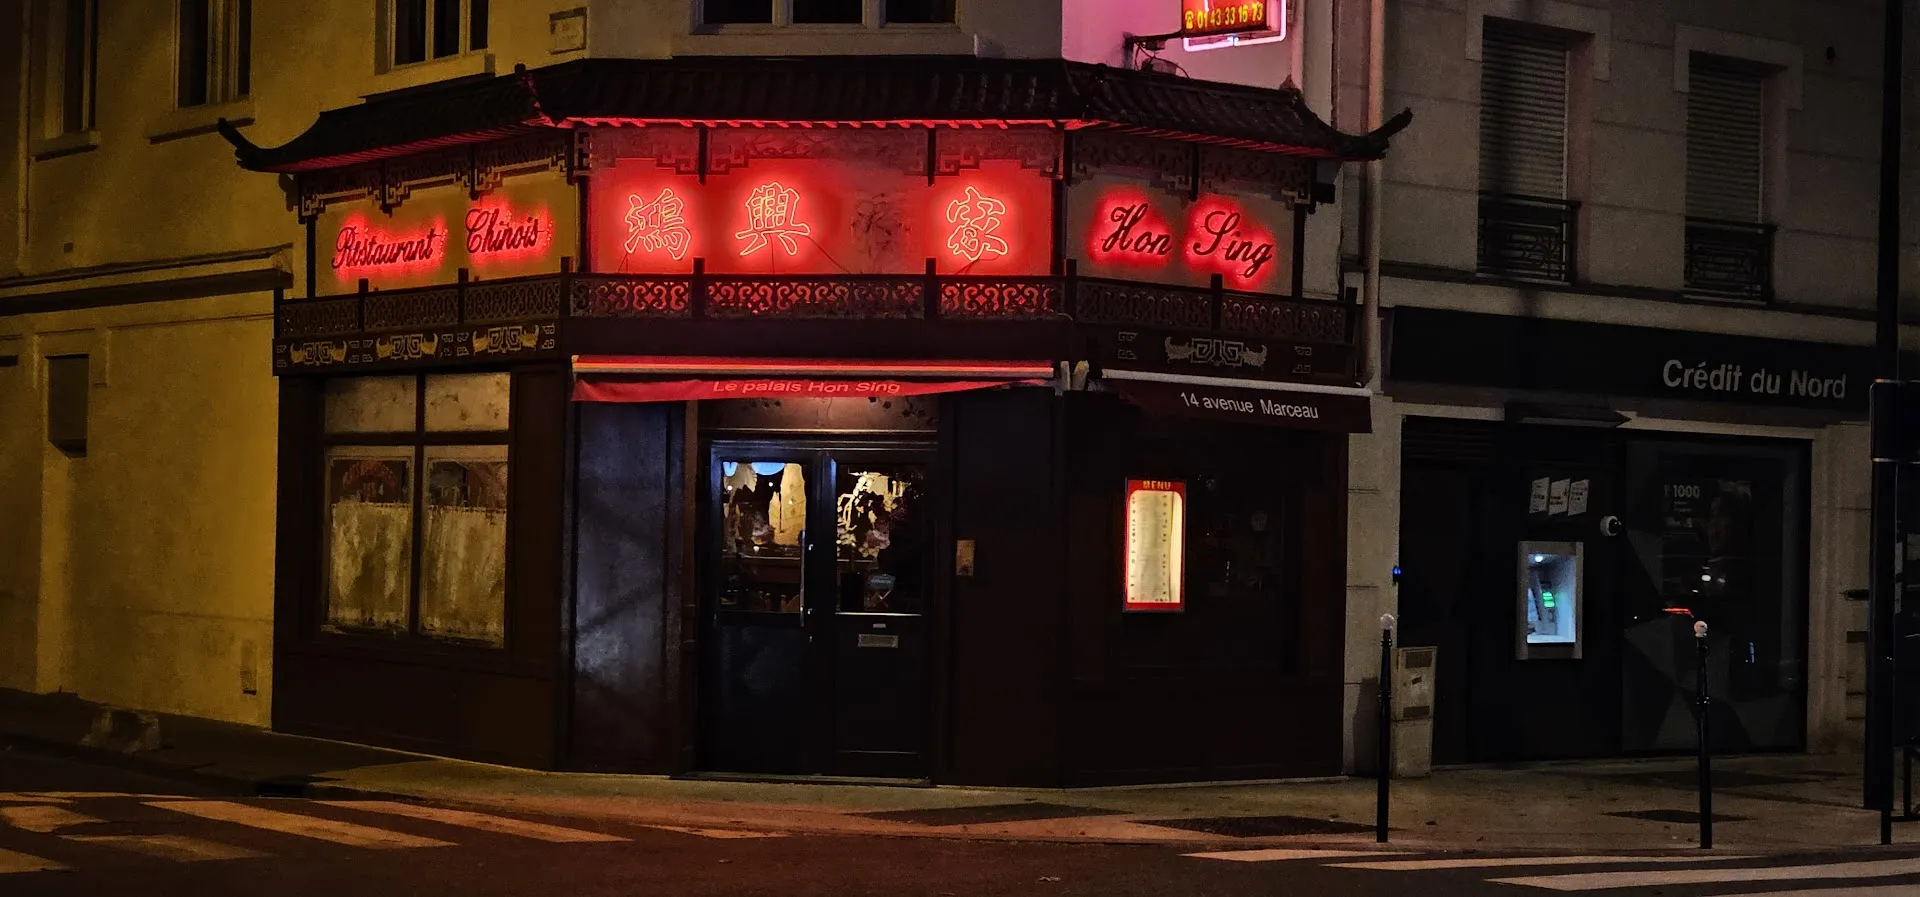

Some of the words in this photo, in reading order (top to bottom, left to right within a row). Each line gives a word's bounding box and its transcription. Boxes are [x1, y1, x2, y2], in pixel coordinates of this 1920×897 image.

[1197, 10, 1208, 29] 01
[1210, 8, 1222, 27] 43
[1225, 6, 1236, 25] 33
[331, 226, 436, 269] Restaurant
[465, 208, 539, 253] Chinois
[1102, 203, 1172, 255] Hon
[1193, 211, 1273, 278] Sing
[713, 381, 737, 392] Le
[742, 381, 801, 394] palais
[807, 382, 849, 393] Hon
[855, 382, 901, 394] Sing
[1663, 359, 1742, 391] Crédit
[1750, 368, 1780, 394] du
[1789, 370, 1846, 399] Nord
[1180, 392, 1199, 408] 14
[1203, 396, 1254, 413] avenue
[1259, 399, 1319, 419] Marceau
[1143, 481, 1171, 489] MENU
